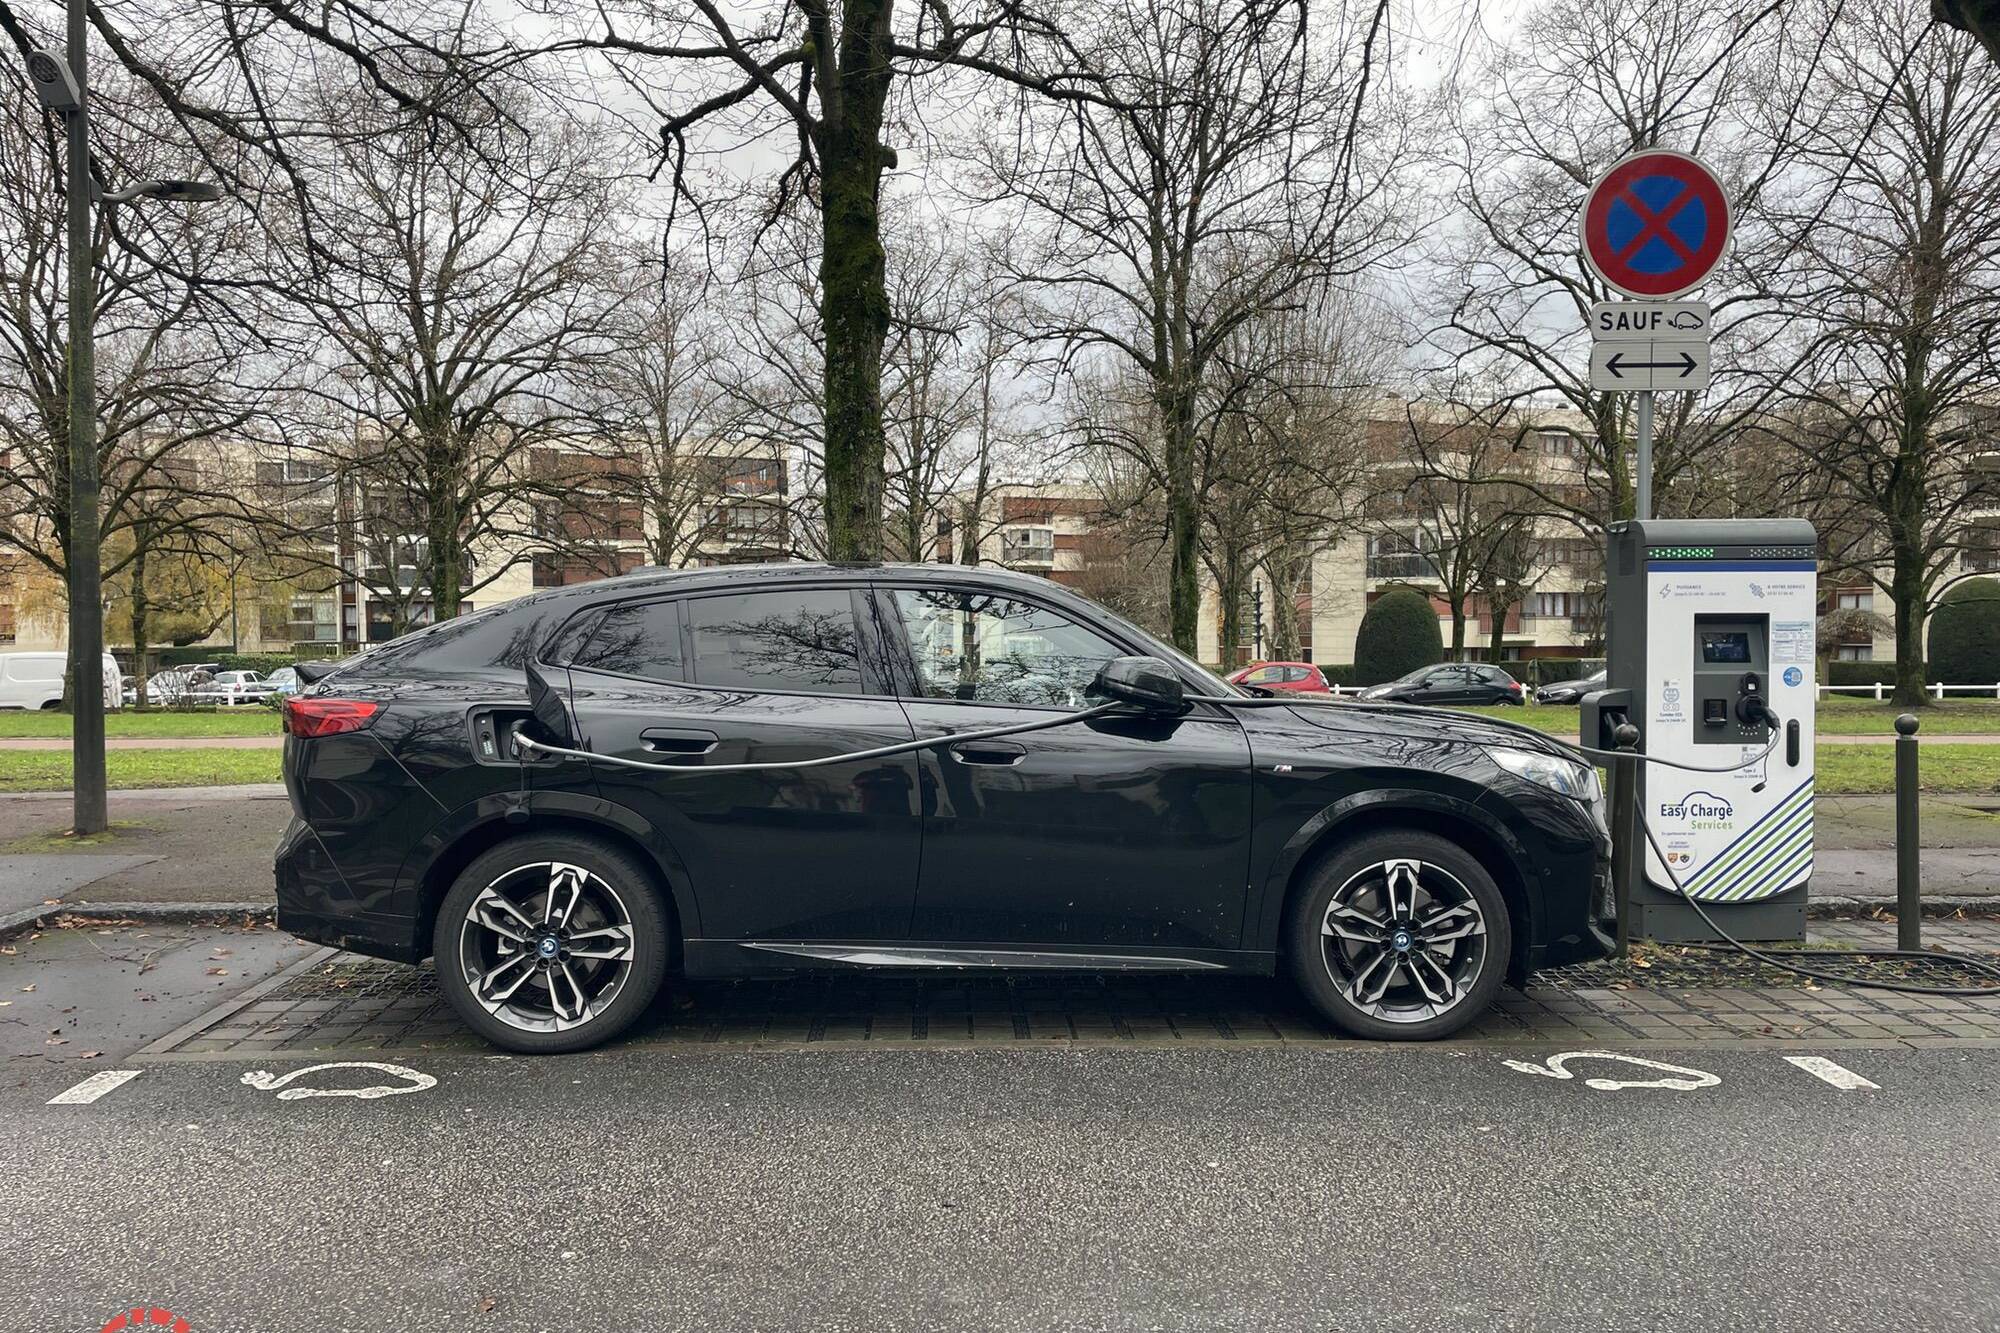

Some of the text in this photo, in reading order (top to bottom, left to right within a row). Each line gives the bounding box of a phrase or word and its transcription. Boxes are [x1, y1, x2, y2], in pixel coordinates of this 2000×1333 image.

[1600, 312, 1663, 330] SAUF
[1661, 803, 1733, 820] Easy Charge
[1691, 820, 1733, 830] Services
